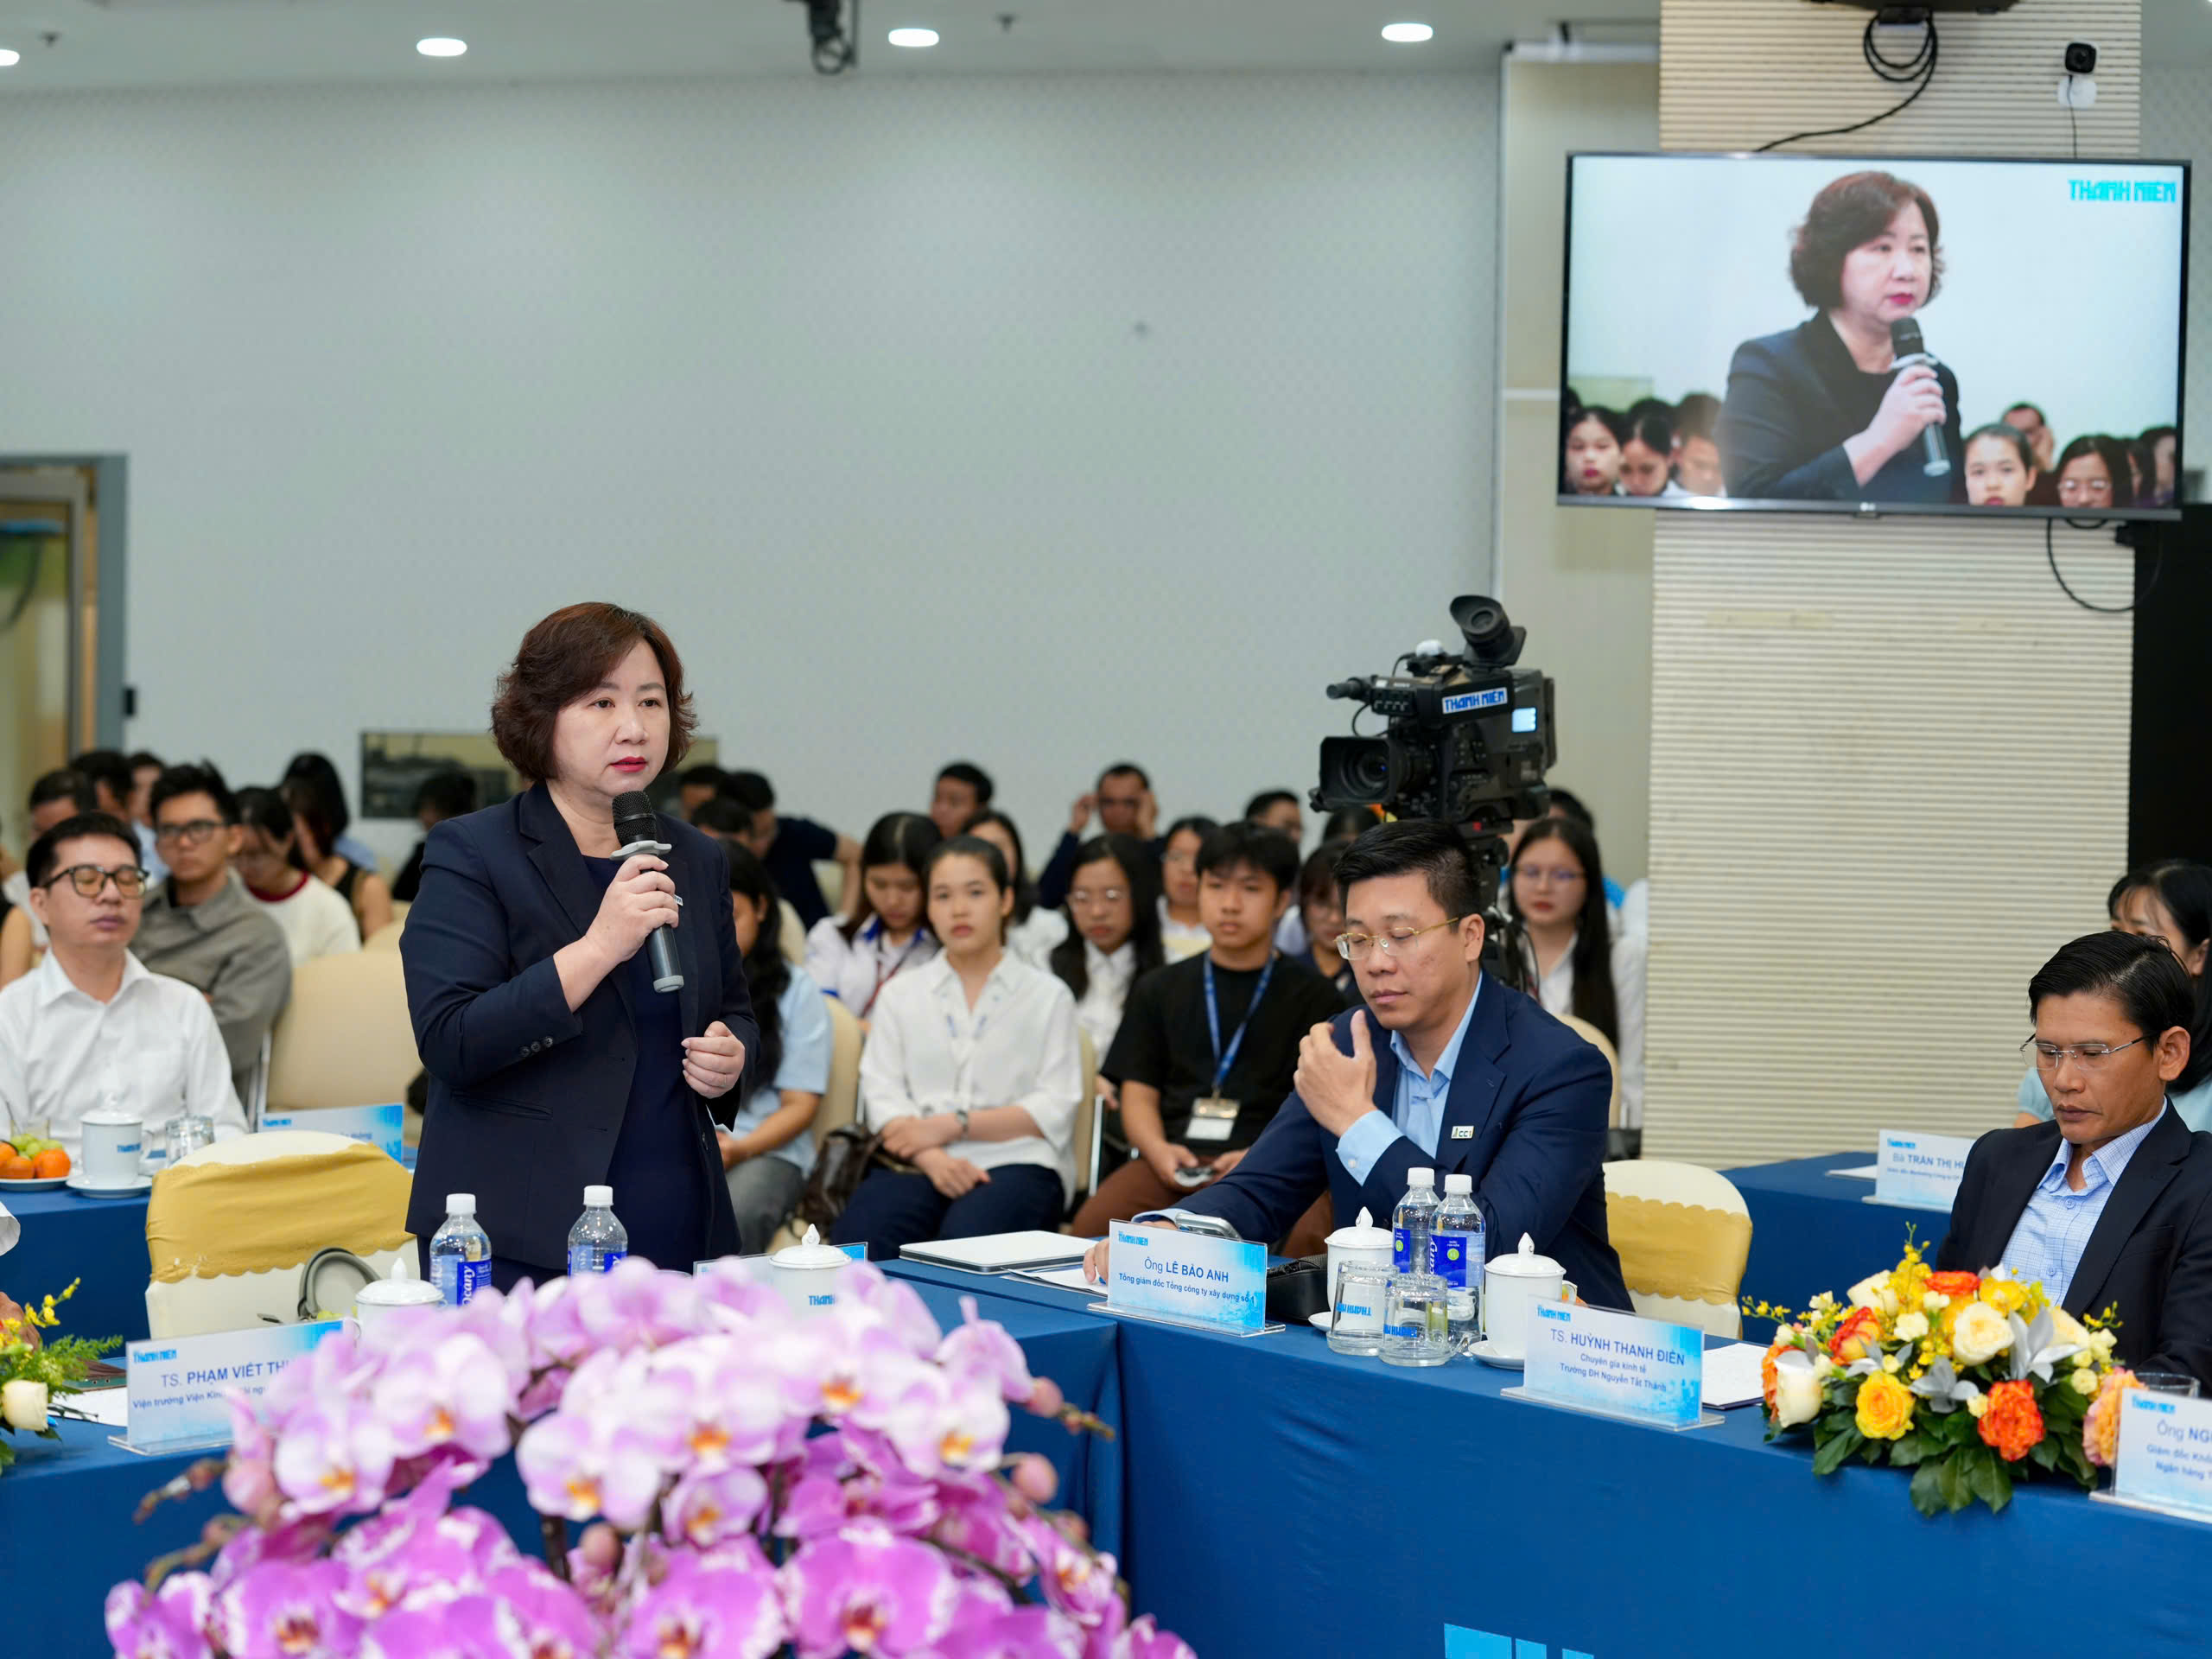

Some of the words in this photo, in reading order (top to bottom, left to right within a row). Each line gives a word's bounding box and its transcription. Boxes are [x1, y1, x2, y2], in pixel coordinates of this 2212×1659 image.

[1144, 1256, 1163, 1274] Ông
[1166, 1261, 1179, 1274] LÊ
[1206, 1268, 1229, 1283] ANH
[1153, 1278, 1165, 1287] đốc
[1184, 1285, 1200, 1295] công
[1210, 1288, 1221, 1299] xây
[1550, 1328, 1567, 1344] TS.
[1571, 1332, 1610, 1351] HUỲNH
[1614, 1340, 1653, 1360] THANH
[1560, 1362, 1587, 1377] Trường
[1601, 1371, 1629, 1384] Nguyễn
[1580, 1353, 1607, 1365] Chuyên
[1610, 1360, 1620, 1370] gia
[1622, 1362, 1637, 1372] kinh
[161, 1373, 182, 1388] TS.
[187, 1368, 228, 1385] PHẠM
[2157, 1419, 2184, 1442] Ông
